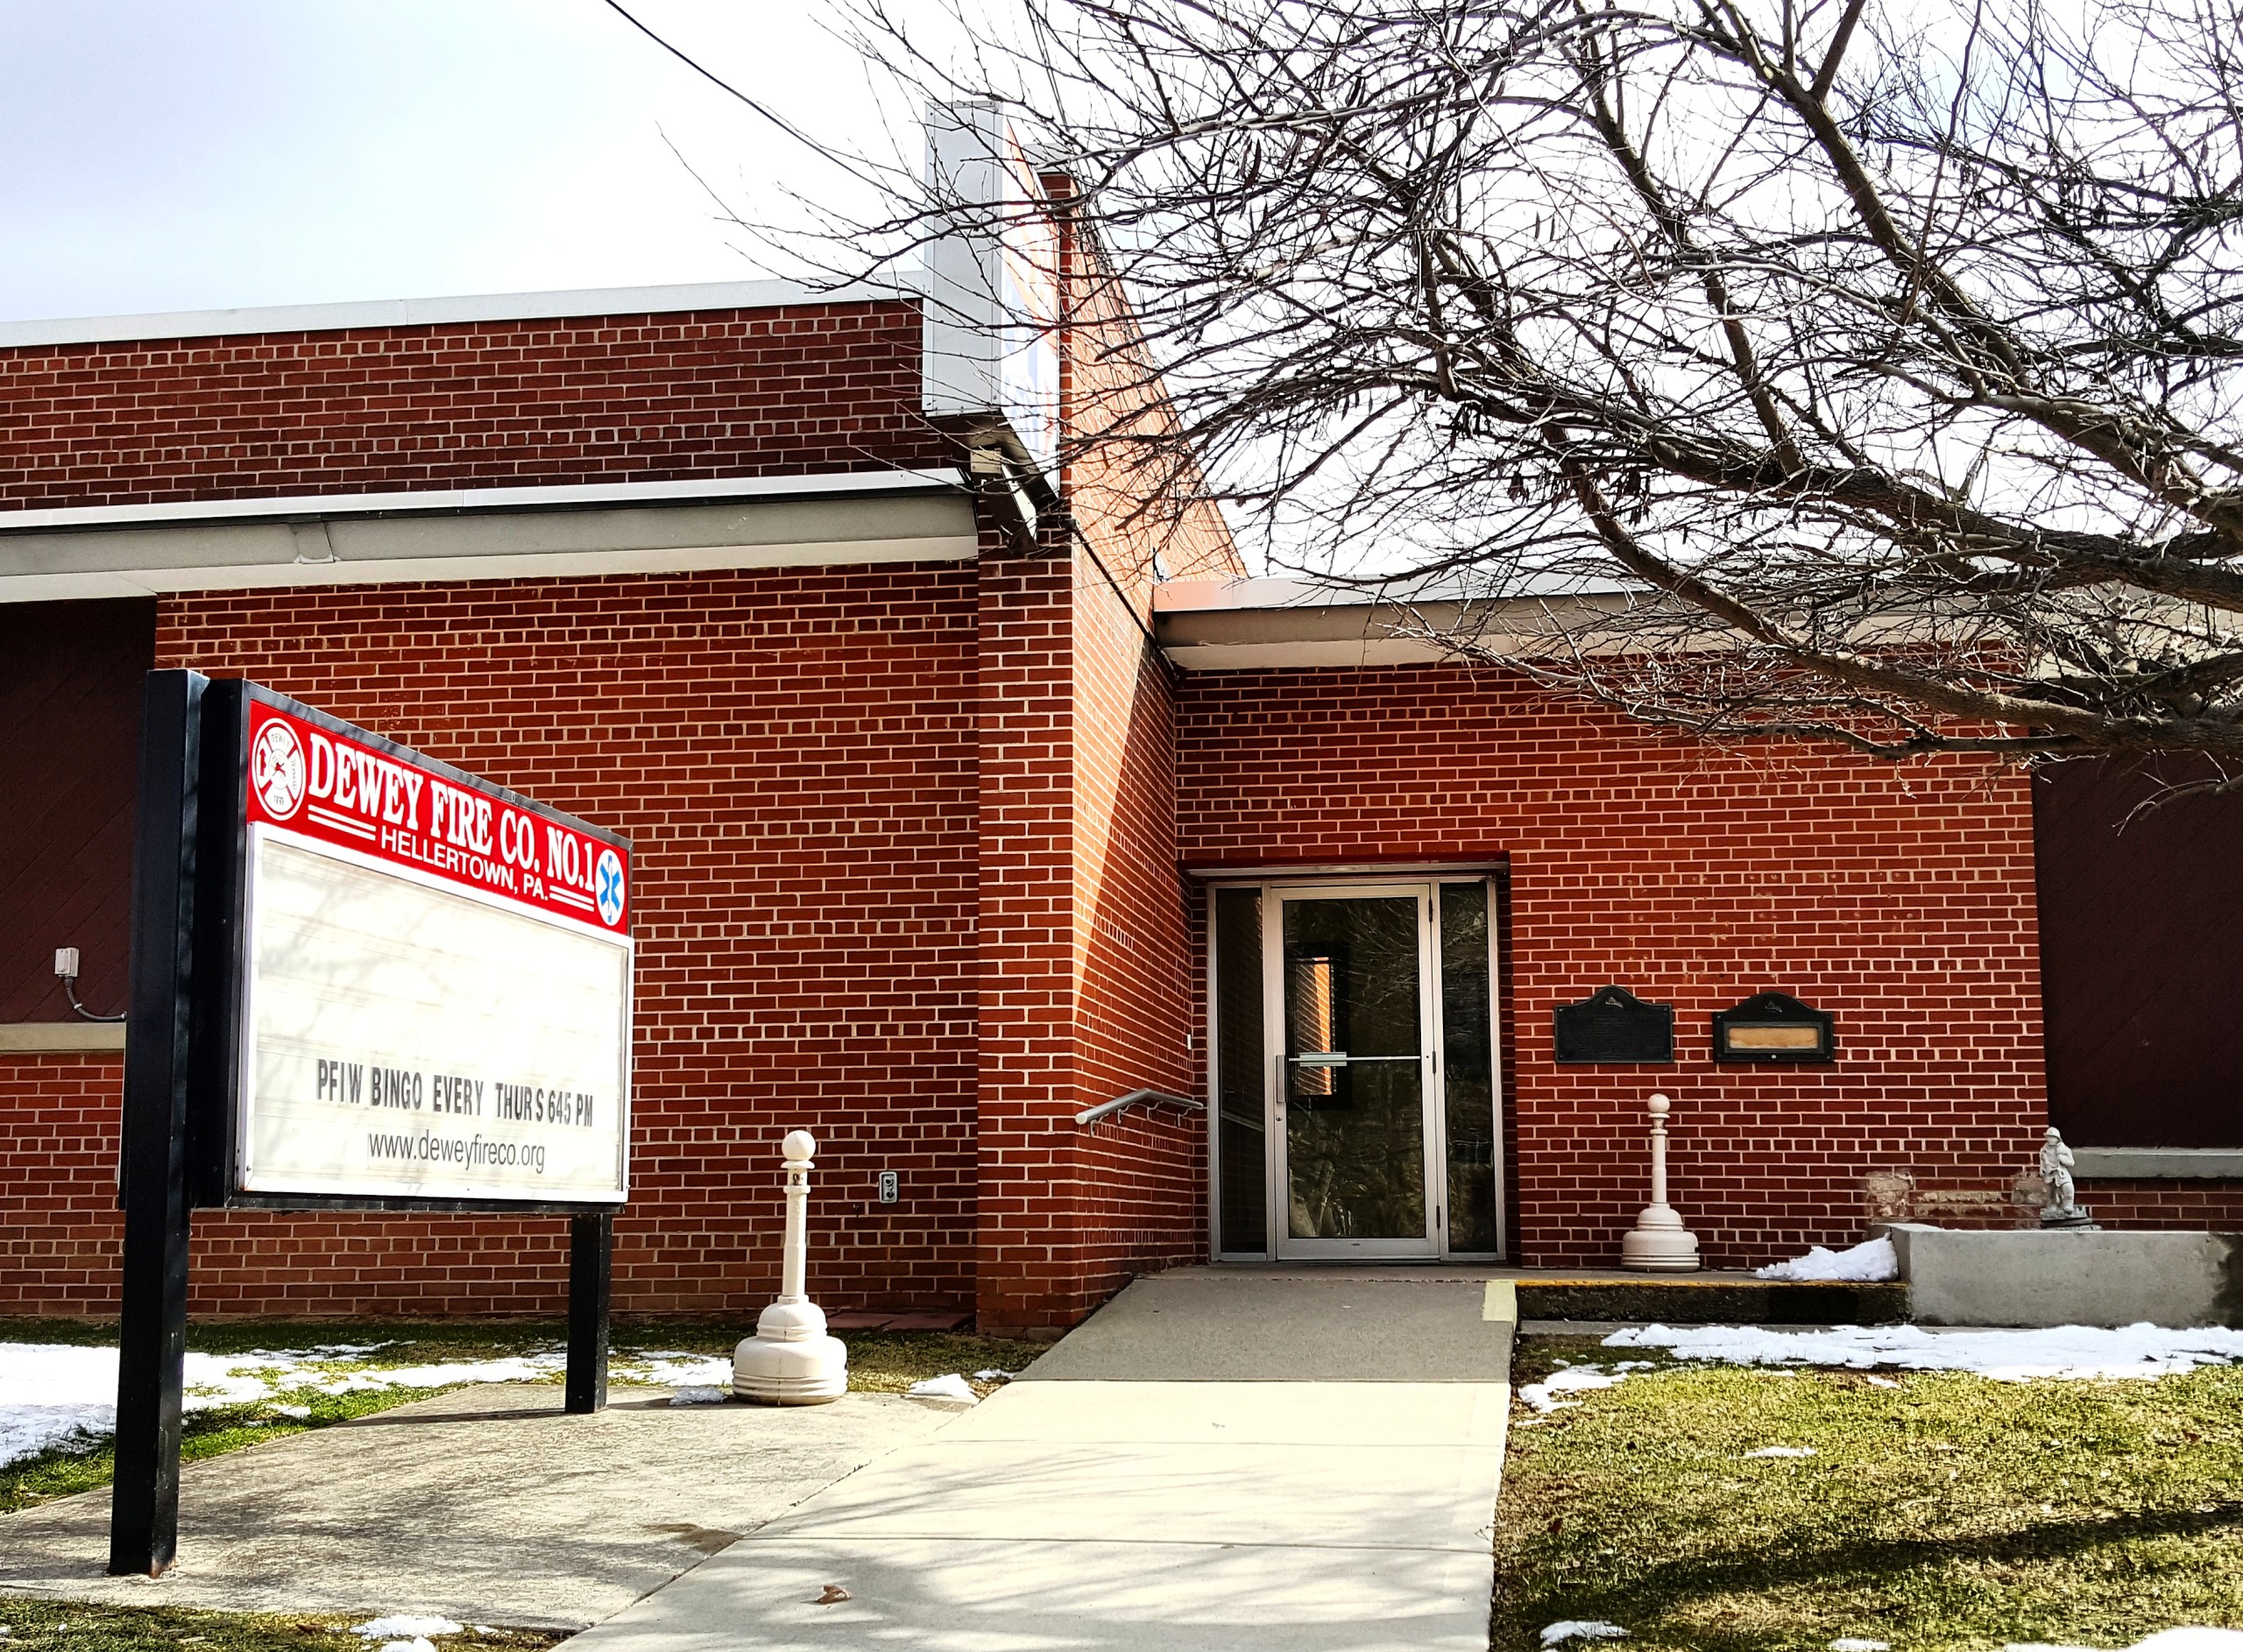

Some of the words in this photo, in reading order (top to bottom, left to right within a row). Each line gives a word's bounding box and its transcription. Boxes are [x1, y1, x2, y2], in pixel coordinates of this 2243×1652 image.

[308, 733, 424, 831] DEWEY
[429, 783, 493, 856] FIRE
[499, 808, 541, 872] CO.
[547, 826, 595, 893] NO.1
[381, 827, 518, 894] HELLERTOWN,
[522, 872, 548, 901] PA.
[371, 1066, 422, 1111] BINGO
[434, 1075, 484, 1116] EVERY
[495, 1083, 544, 1122] THURS
[548, 1090, 571, 1126] 645
[576, 1093, 593, 1127] PM
[368, 1129, 545, 1174] www.deweyfireco.org
